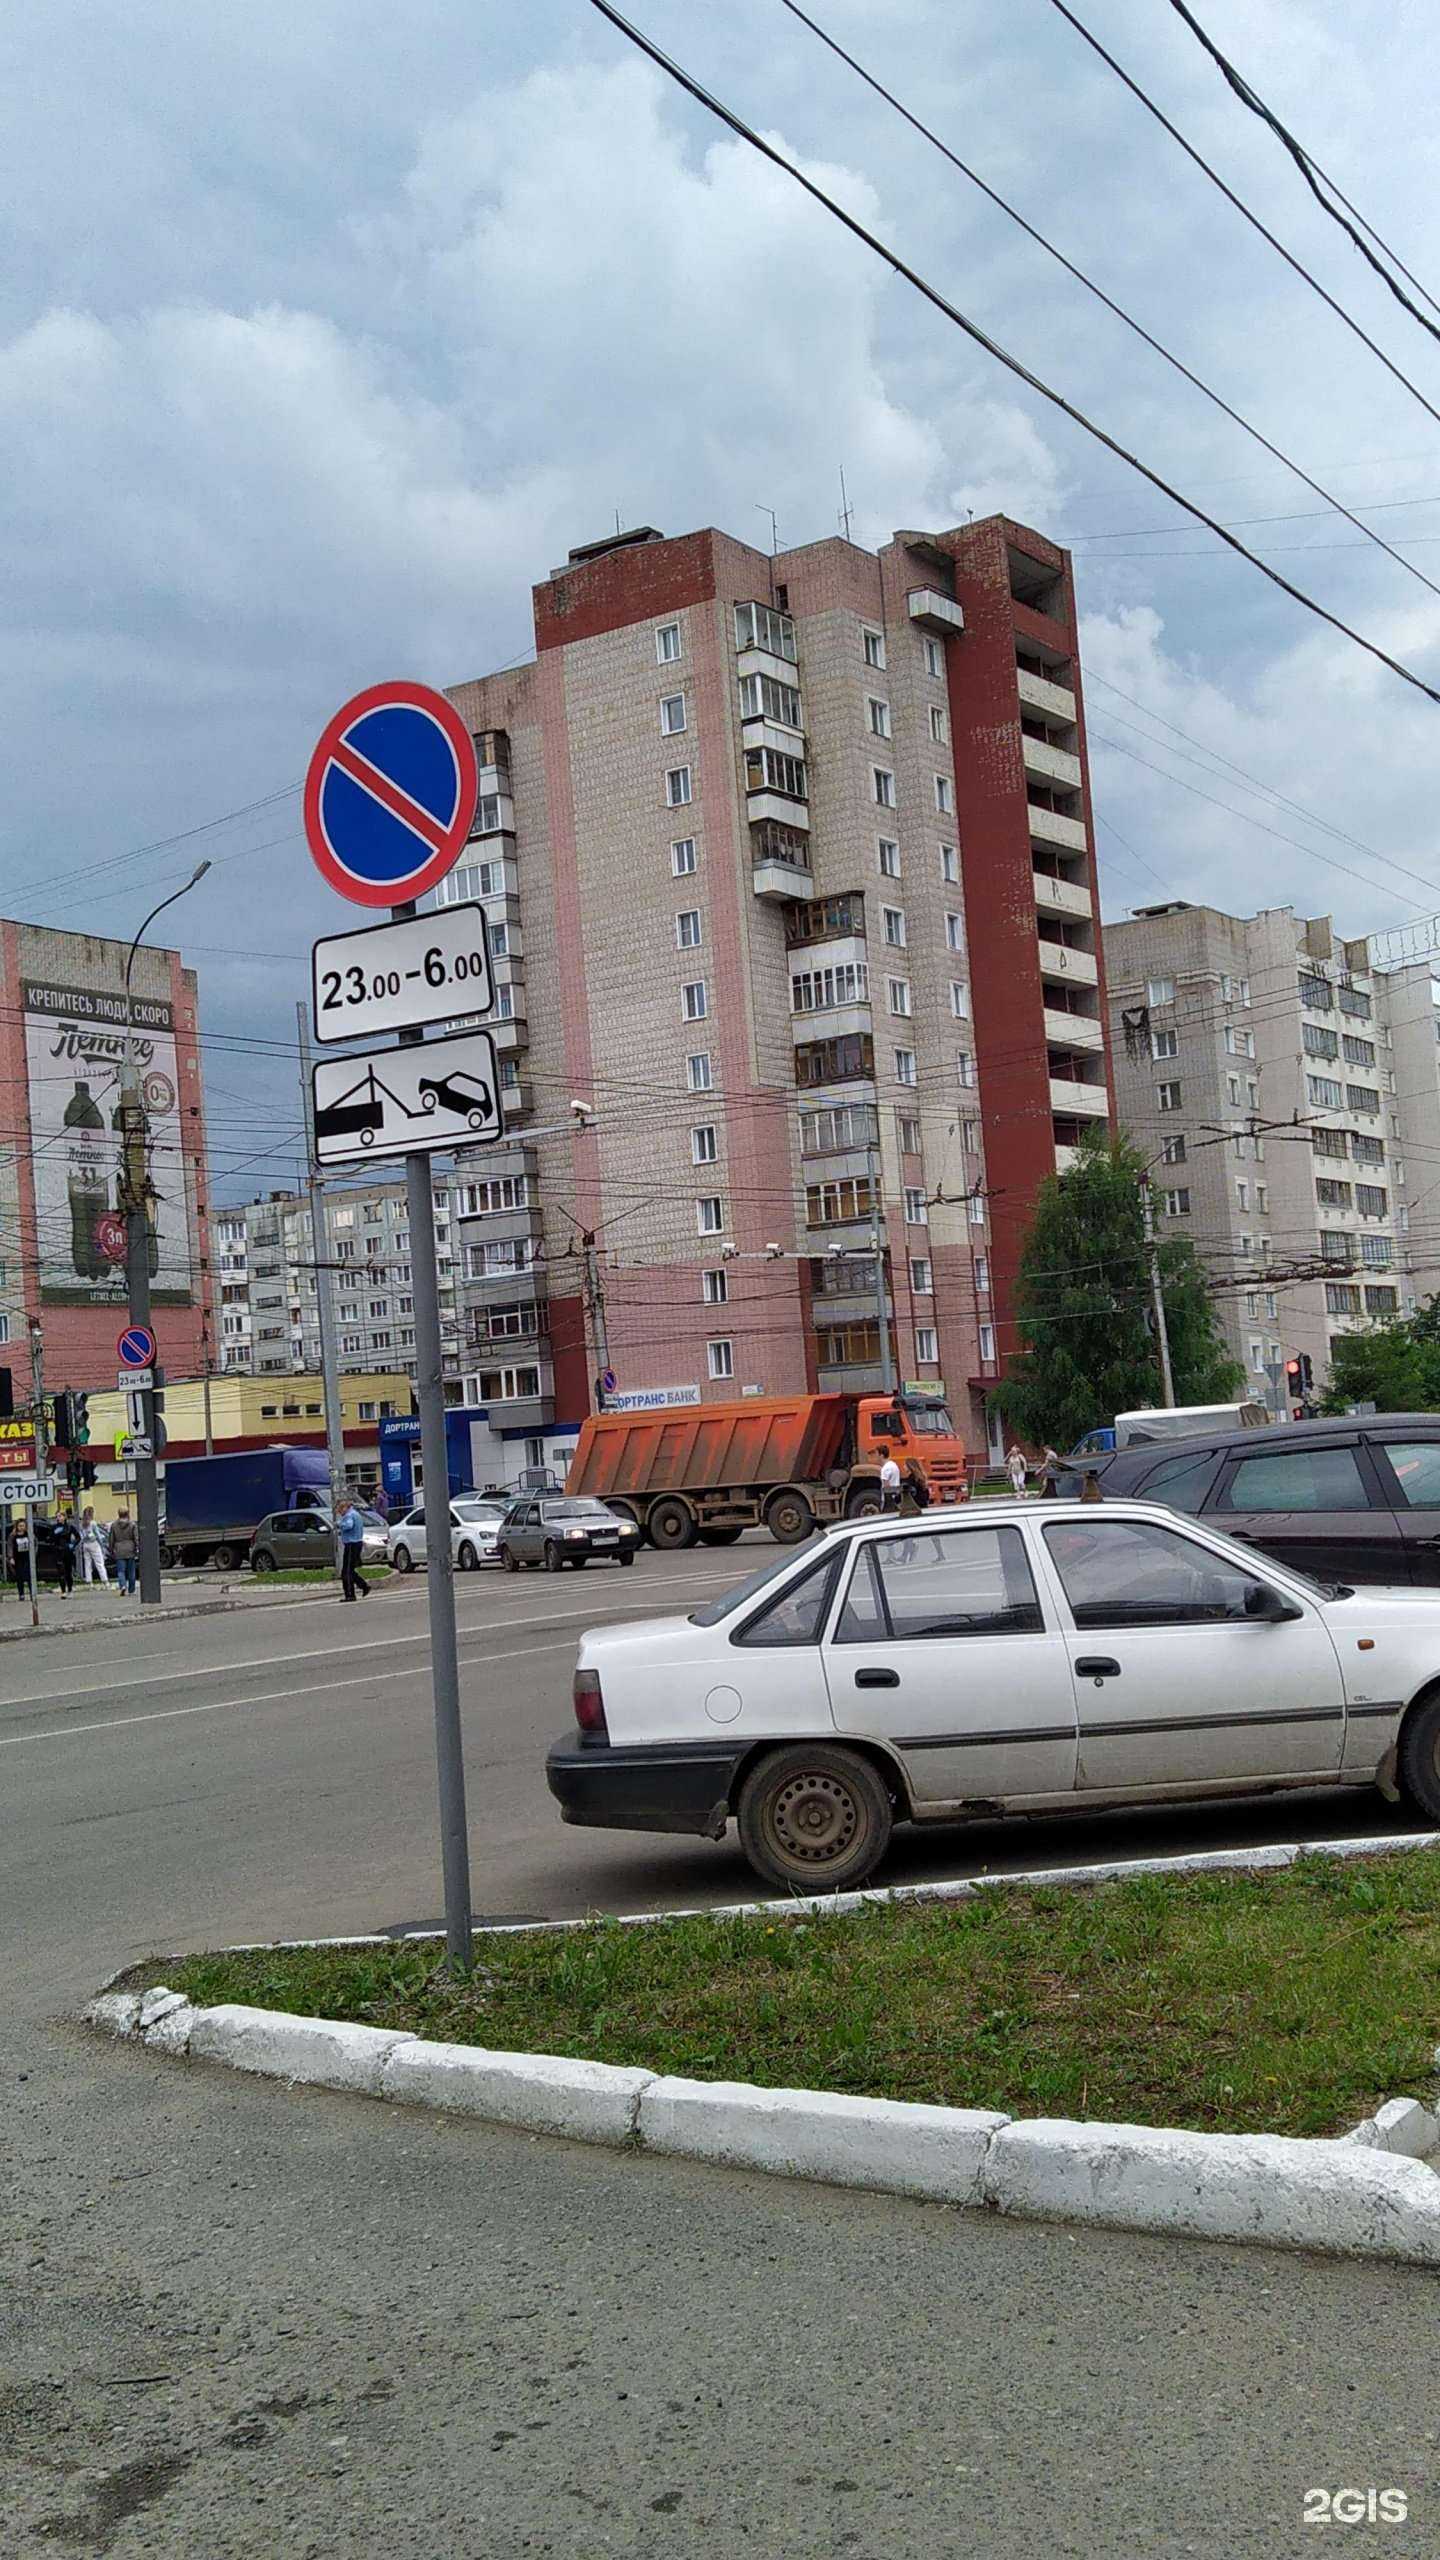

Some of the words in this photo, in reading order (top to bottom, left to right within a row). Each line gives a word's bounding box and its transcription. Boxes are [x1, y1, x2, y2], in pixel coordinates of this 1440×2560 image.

[28, 987, 93, 1013] КРЕПИТЕСЬ
[134, 1004, 169, 1025] СКОРО
[615, 1393, 665, 1408] ОРТРАНС
[667, 1389, 696, 1403] БАНК
[384, 1421, 421, 1434] ДОРТРАН
[2, 1452, 27, 1463] ТЫ
[3, 1483, 48, 1500] СТОП
